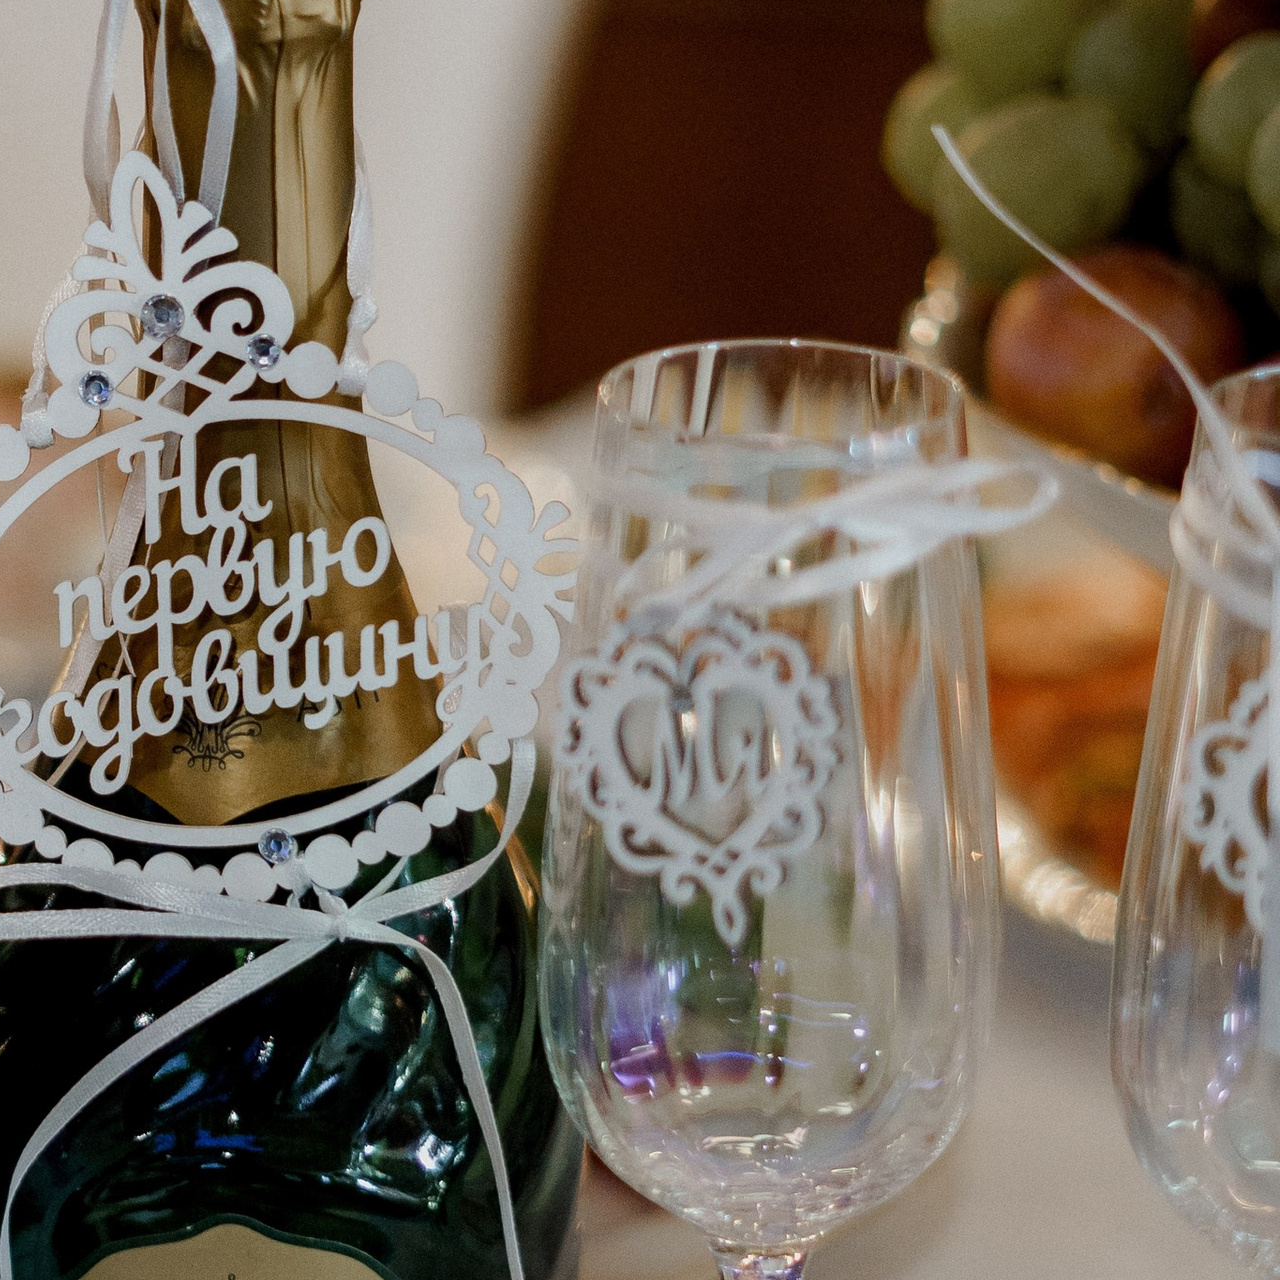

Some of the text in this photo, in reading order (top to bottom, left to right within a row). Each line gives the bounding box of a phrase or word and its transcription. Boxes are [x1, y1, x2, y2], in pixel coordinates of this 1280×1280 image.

[119, 433, 274, 544] На
[54, 516, 392, 672] первую
[0, 604, 486, 796] годовщину
